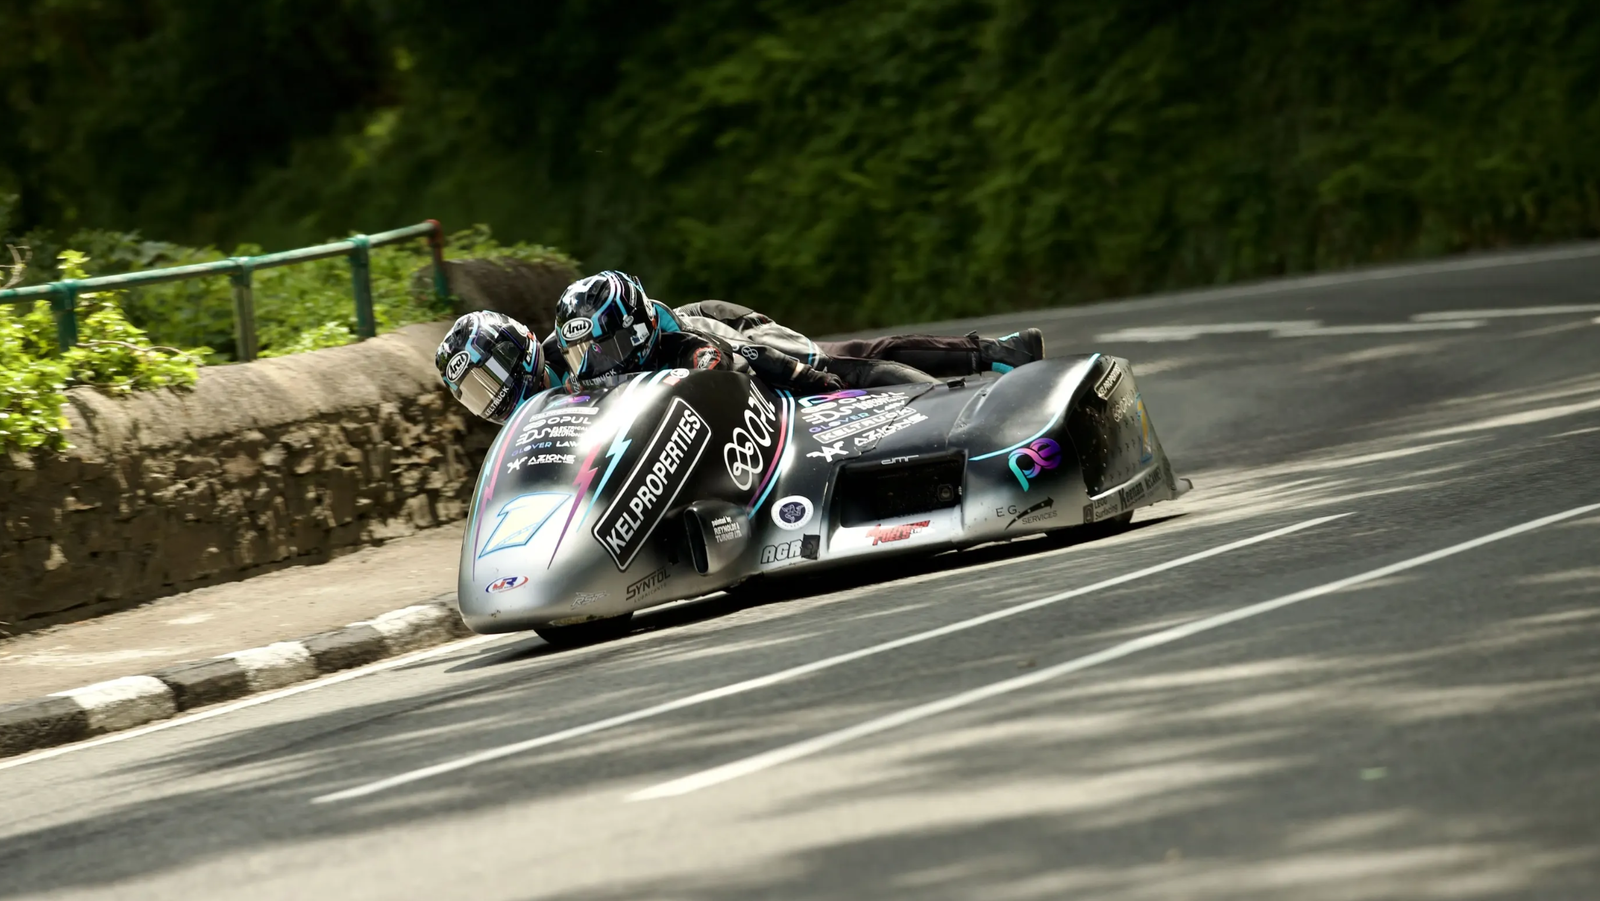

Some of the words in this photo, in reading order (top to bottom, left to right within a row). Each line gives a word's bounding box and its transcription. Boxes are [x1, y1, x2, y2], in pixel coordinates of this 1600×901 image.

[564, 321, 588, 336] Arai
[449, 353, 466, 375] Arai
[547, 416, 592, 425] OPUL
[809, 412, 870, 433] GLOVER
[820, 407, 913, 441] KELTRUCK
[854, 413, 929, 446] AZIONE
[511, 441, 553, 457] GLOVER
[528, 454, 577, 464] AZIONE
[605, 409, 701, 555] KELPROPERTIES
[995, 507, 1006, 518] E
[1021, 510, 1059, 526] SERVICES
[1094, 504, 1119, 521] Surfacing
[477, 489, 575, 560] 1
